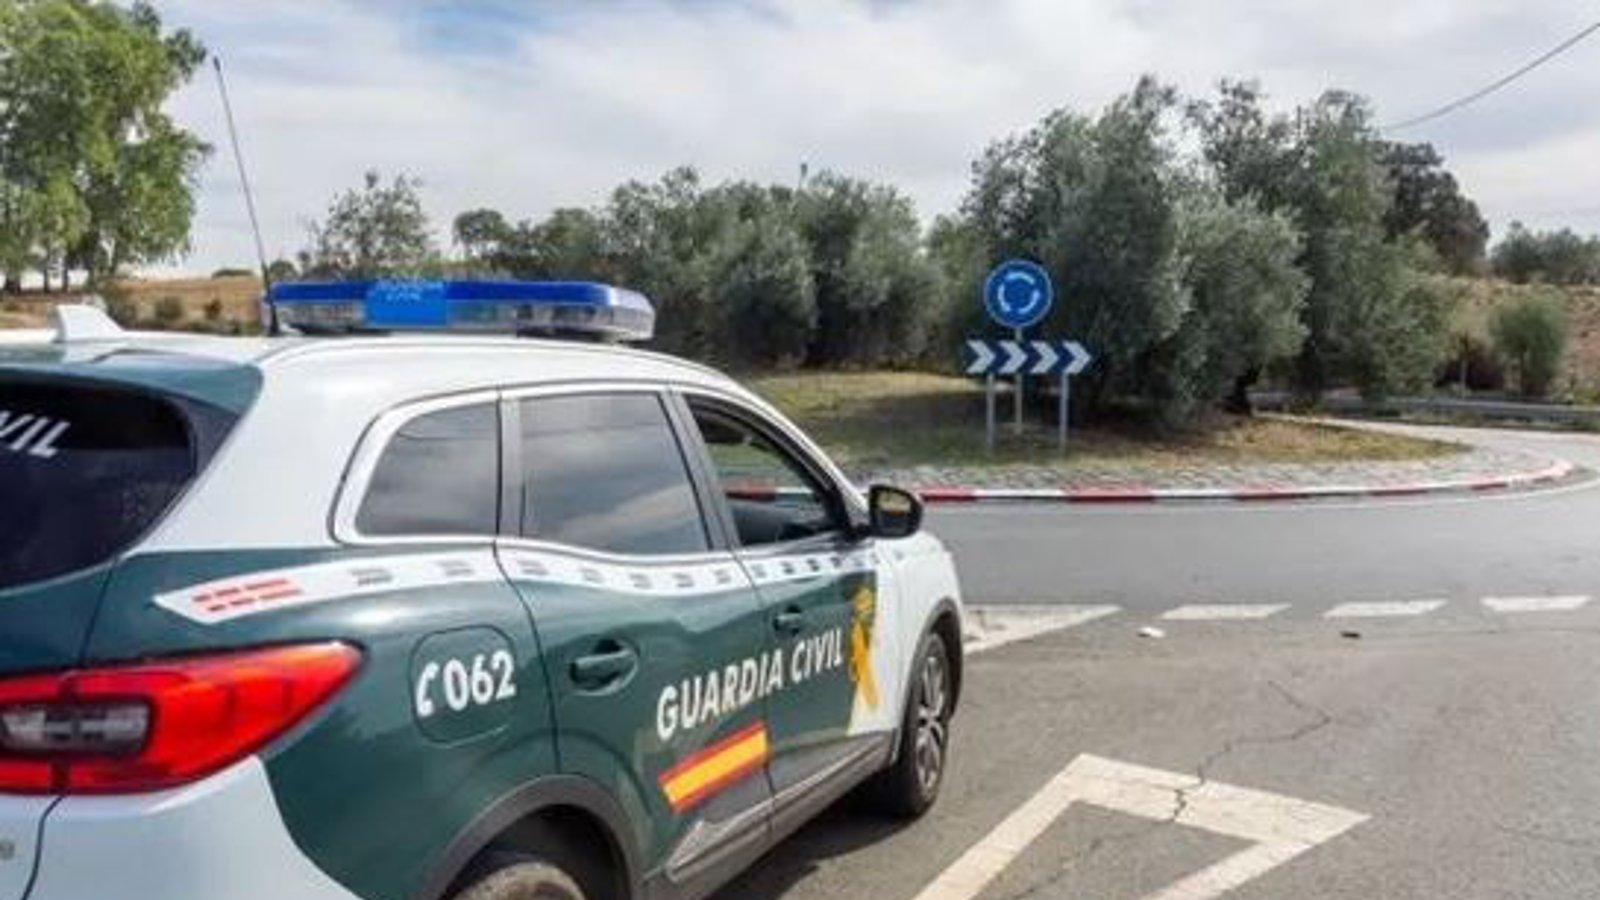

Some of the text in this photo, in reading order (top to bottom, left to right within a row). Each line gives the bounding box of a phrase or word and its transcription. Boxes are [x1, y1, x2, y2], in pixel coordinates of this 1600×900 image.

[443, 649, 516, 711] 062
[657, 627, 843, 741] GUARDIA CIVIL
